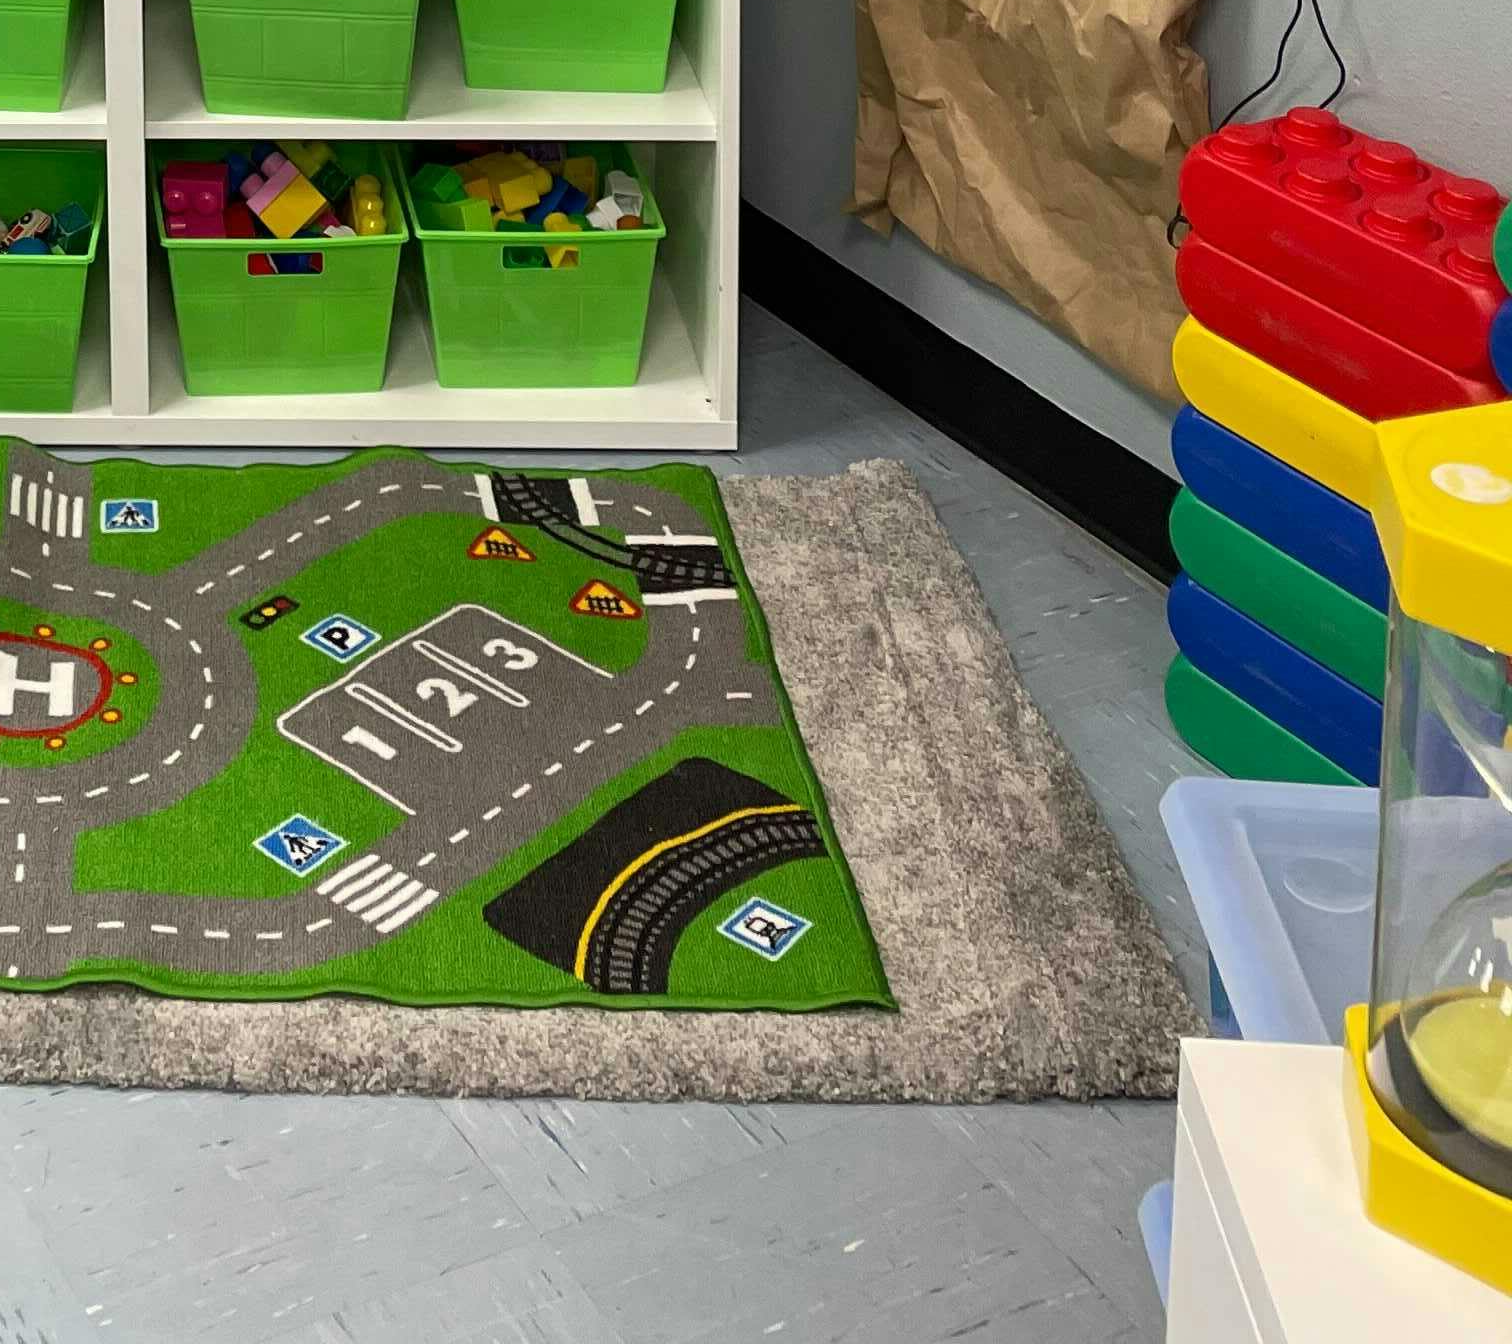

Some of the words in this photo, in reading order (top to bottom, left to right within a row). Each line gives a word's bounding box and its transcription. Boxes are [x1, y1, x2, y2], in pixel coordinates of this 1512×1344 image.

[320, 626, 350, 650] P
[342, 724, 397, 760] 1
[416, 678, 479, 717] 2
[482, 638, 539, 670] 3
